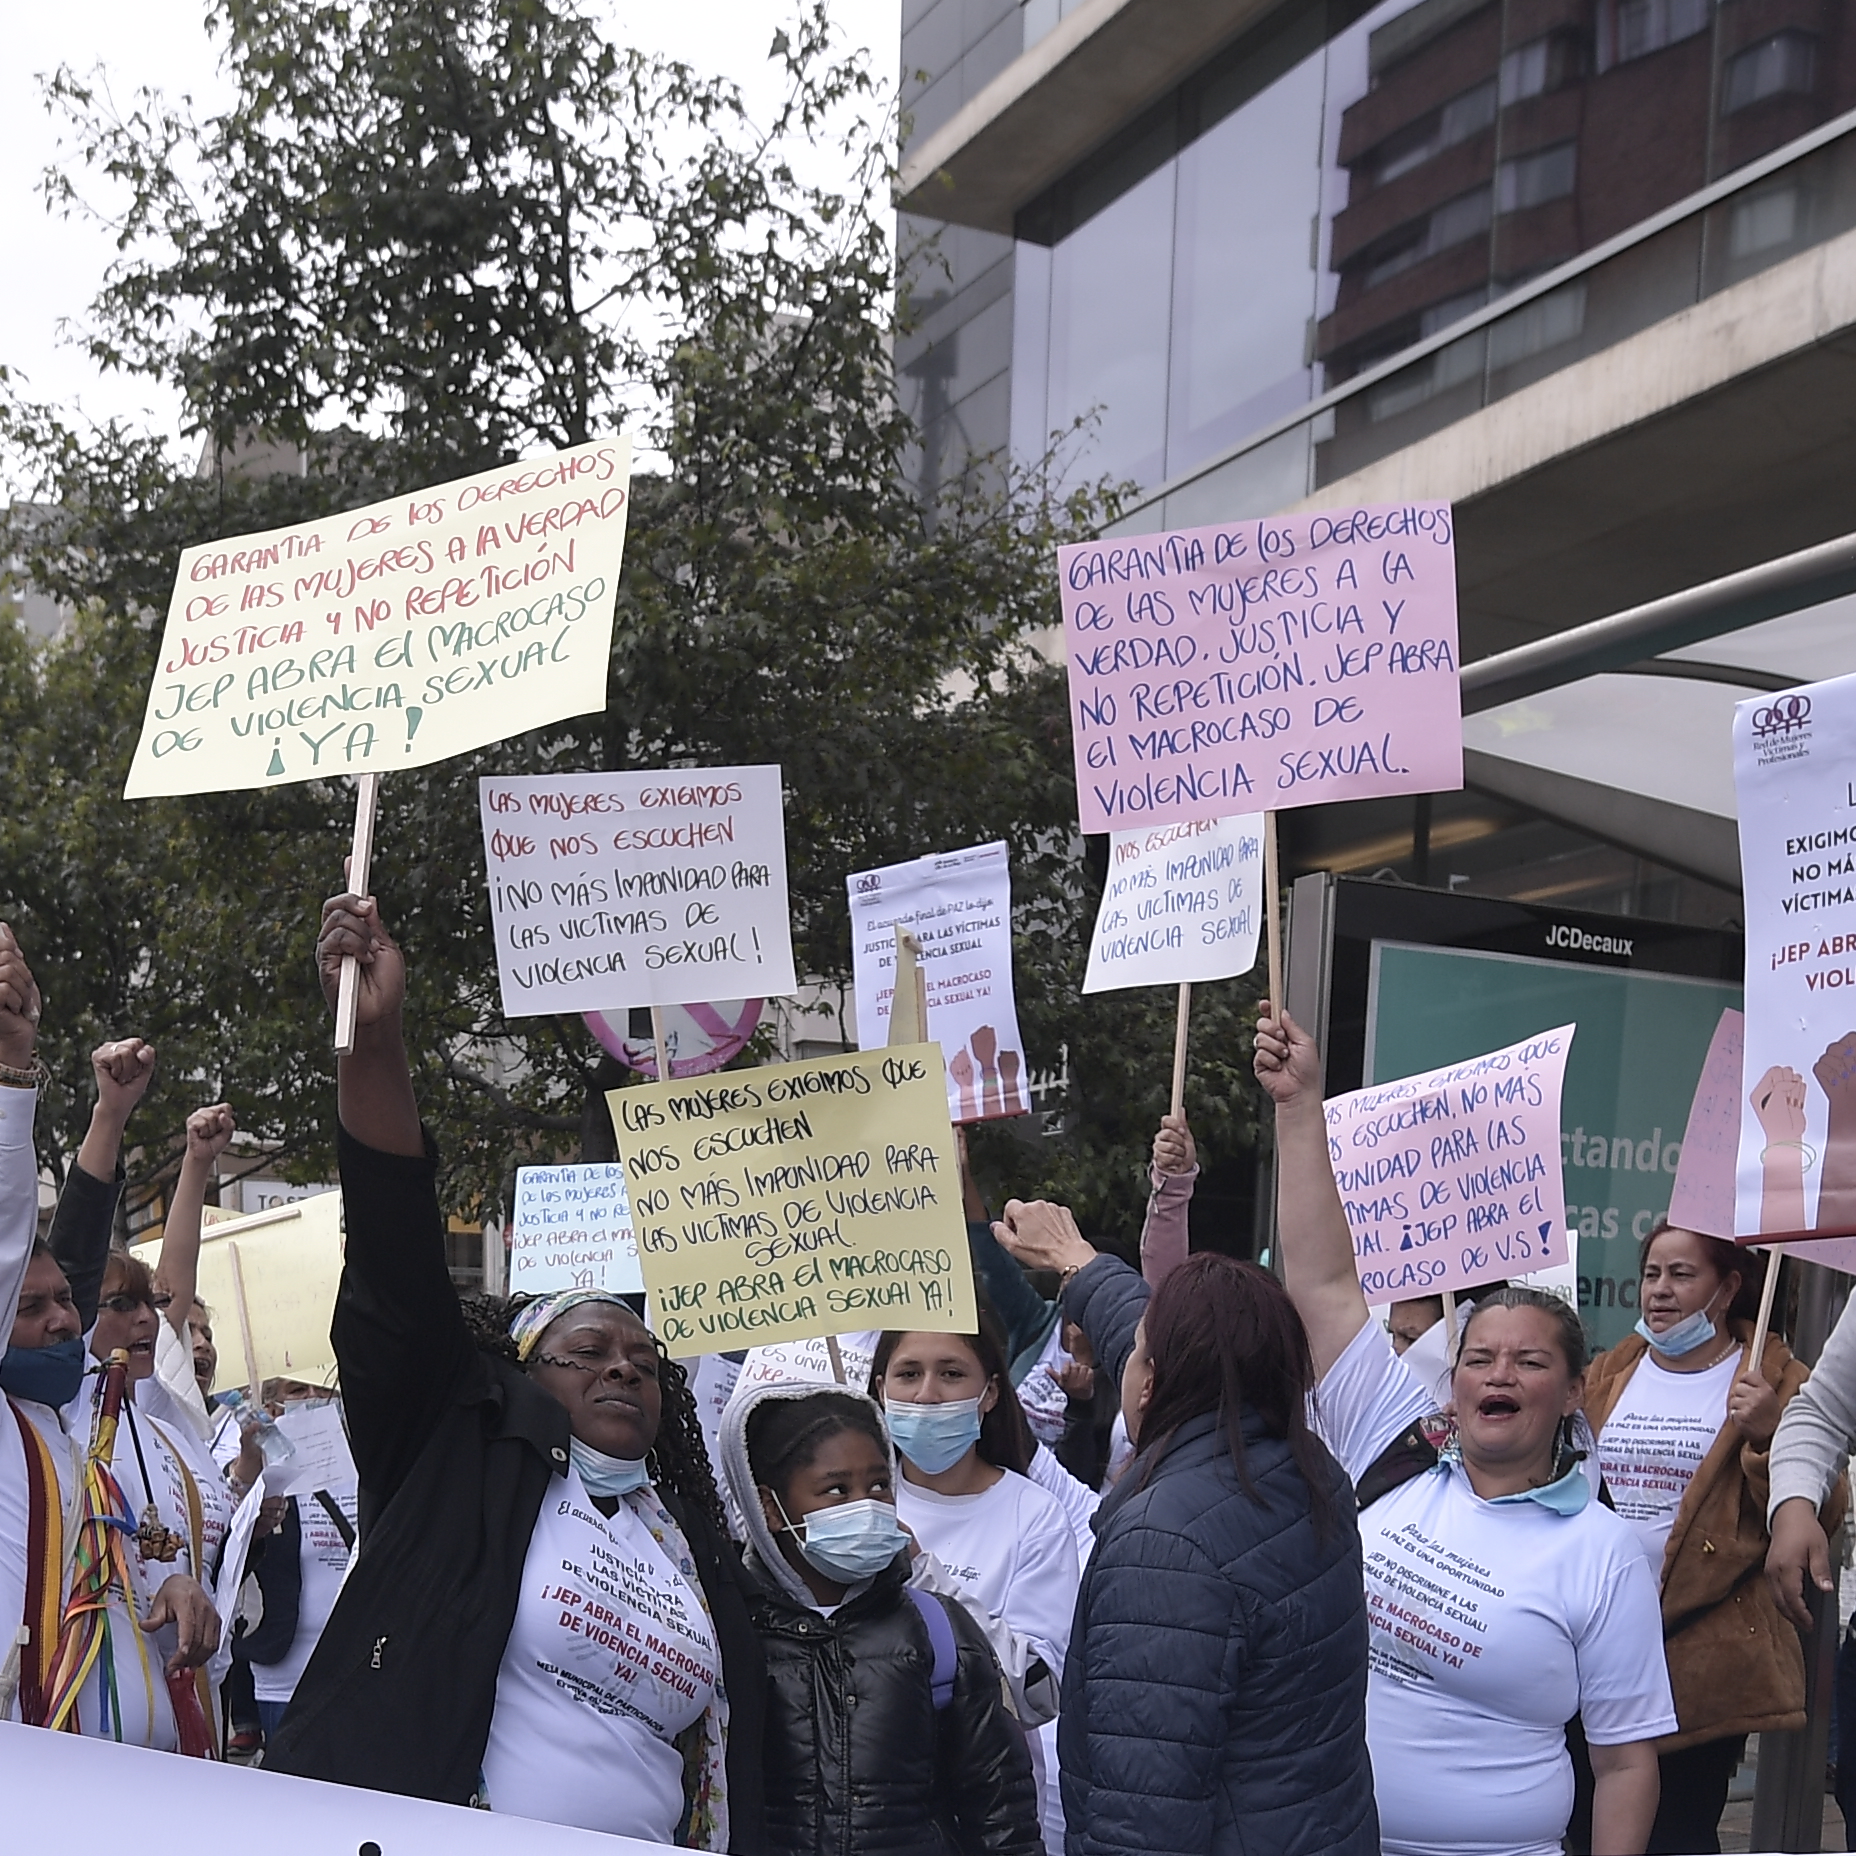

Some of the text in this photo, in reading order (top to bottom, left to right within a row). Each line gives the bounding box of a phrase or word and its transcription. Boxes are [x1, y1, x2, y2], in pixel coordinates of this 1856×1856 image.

[191, 535, 326, 582] GARANTIA
[347, 518, 391, 541] DE
[458, 448, 615, 508] DERECHOS
[186, 596, 230, 621] DE
[294, 549, 434, 601] MUJERES
[446, 538, 466, 564] A
[506, 489, 625, 545] VERDAD
[1068, 535, 1204, 591] GARANTIA
[1215, 534, 1248, 565] DE
[1309, 507, 1453, 551] DERECHOS
[165, 621, 306, 673] JUSTICIA
[355, 601, 392, 634] NO
[405, 540, 575, 616] REPETICIÓN
[1074, 602, 1114, 632] DE
[1188, 565, 1318, 626] MUJERES
[1336, 558, 1358, 590] A
[1220, 603, 1364, 663] JUSTICIA
[1382, 600, 1406, 635] Y
[530, 793, 625, 821] MUJERES
[639, 782, 743, 808] EXIGIMOS
[491, 816, 735, 863] QUE NOS ESCUCHEN
[551, 870, 608, 907] MÁS
[731, 863, 771, 891] PARA
[1792, 864, 1821, 885] NO
[1545, 925, 1634, 957] JCDecaux
[1771, 943, 1811, 972] ¡JEP
[670, 1085, 762, 1122] MUJERES
[768, 1066, 871, 1101] EXIGIMOS
[882, 1058, 926, 1089] QUE
[629, 1111, 813, 1180] NOS ESCUCHEN
